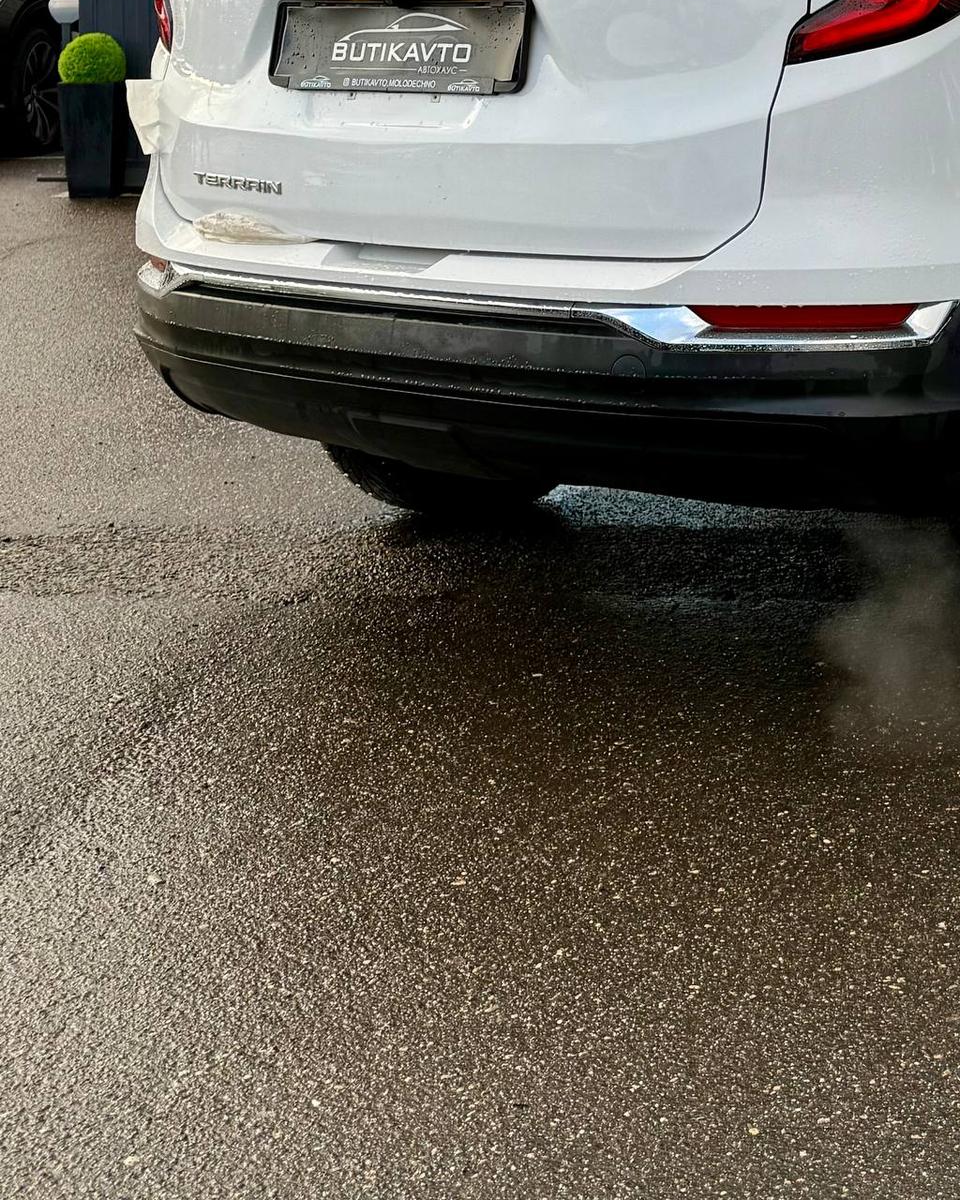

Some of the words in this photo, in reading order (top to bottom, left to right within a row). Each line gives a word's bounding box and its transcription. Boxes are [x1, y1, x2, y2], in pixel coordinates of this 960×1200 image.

[331, 42, 472, 63] BUTIKAVTO
[417, 65, 458, 75] АВТОХАУС
[193, 171, 283, 195] TERRAIN
